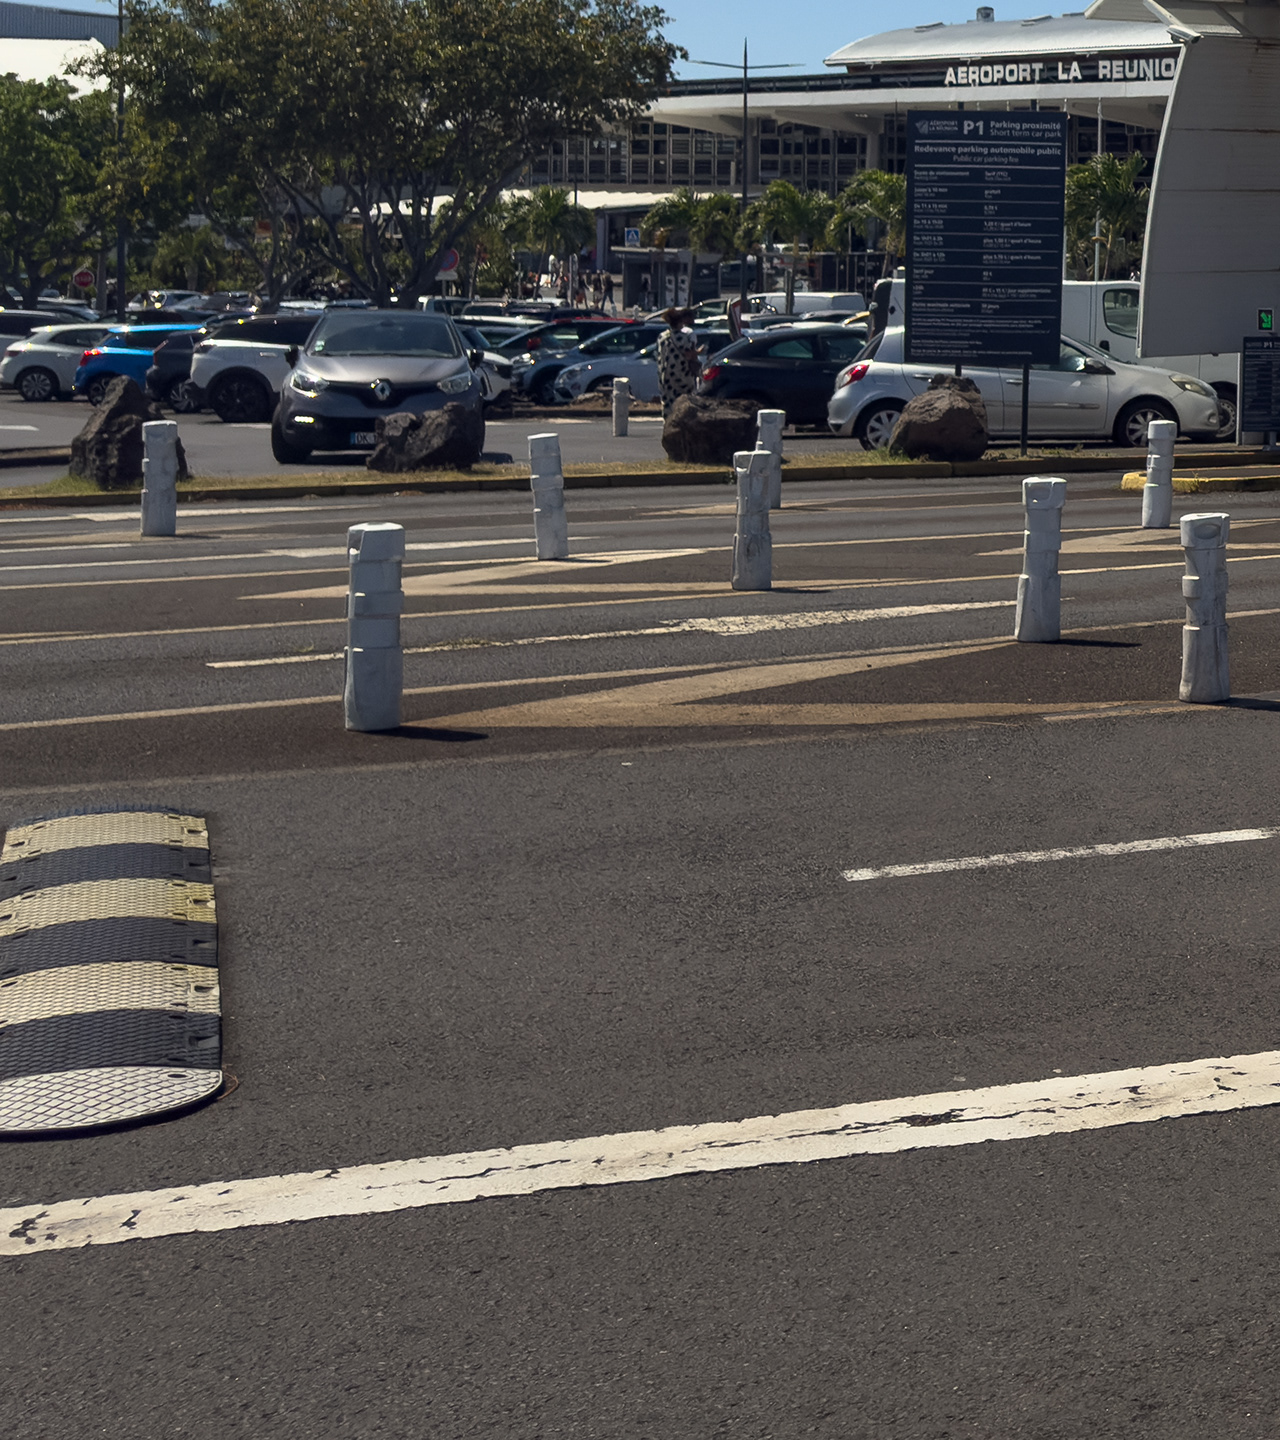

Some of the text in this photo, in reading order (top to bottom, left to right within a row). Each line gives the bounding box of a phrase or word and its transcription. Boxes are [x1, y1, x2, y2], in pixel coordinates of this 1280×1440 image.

[944, 57, 1176, 85] AEROPORT LA REUNIO
[963, 120, 984, 135] P1
[990, 121, 1061, 131] Parking proximité
[1045, 131, 1062, 139] park
[958, 146, 988, 154] parking
[990, 146, 1035, 155] automobile
[1037, 147, 1061, 155] public
